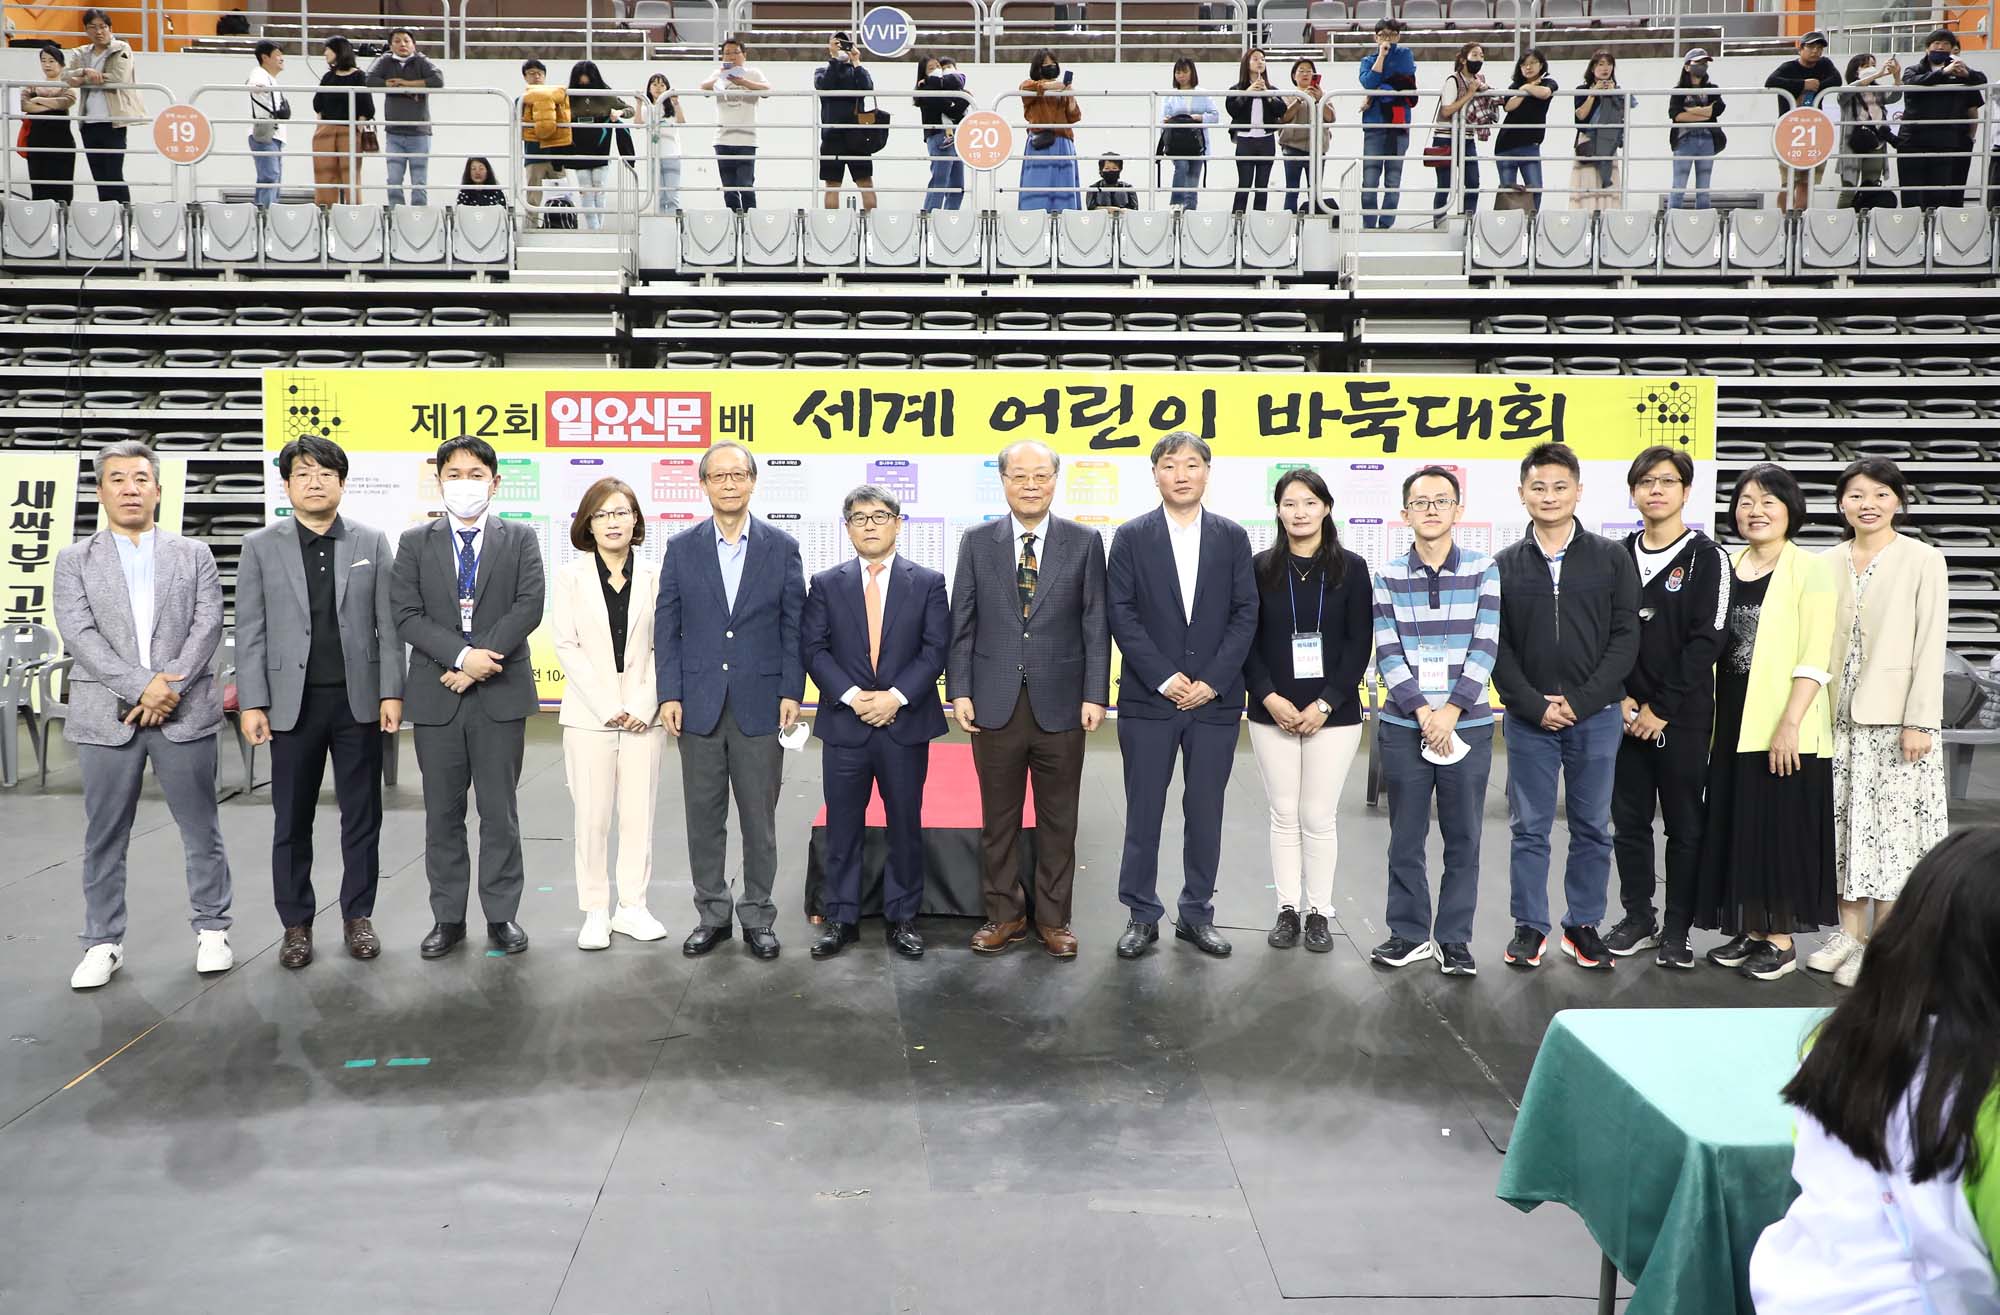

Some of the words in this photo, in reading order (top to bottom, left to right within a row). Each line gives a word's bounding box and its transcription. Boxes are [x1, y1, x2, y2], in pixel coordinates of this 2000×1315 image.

[864, 24, 907, 40] VVIP
[168, 121, 195, 143] 19
[969, 128, 999, 149] 20
[1791, 125, 1817, 147] 21
[410, 402, 538, 441] 제12회
[551, 397, 702, 442] 일요신문
[719, 403, 754, 442] 배
[792, 388, 955, 440] 세계
[989, 387, 1217, 451] 어린이
[1257, 381, 1566, 453] 바둑대회
[8, 480, 56, 573] 새싹부
